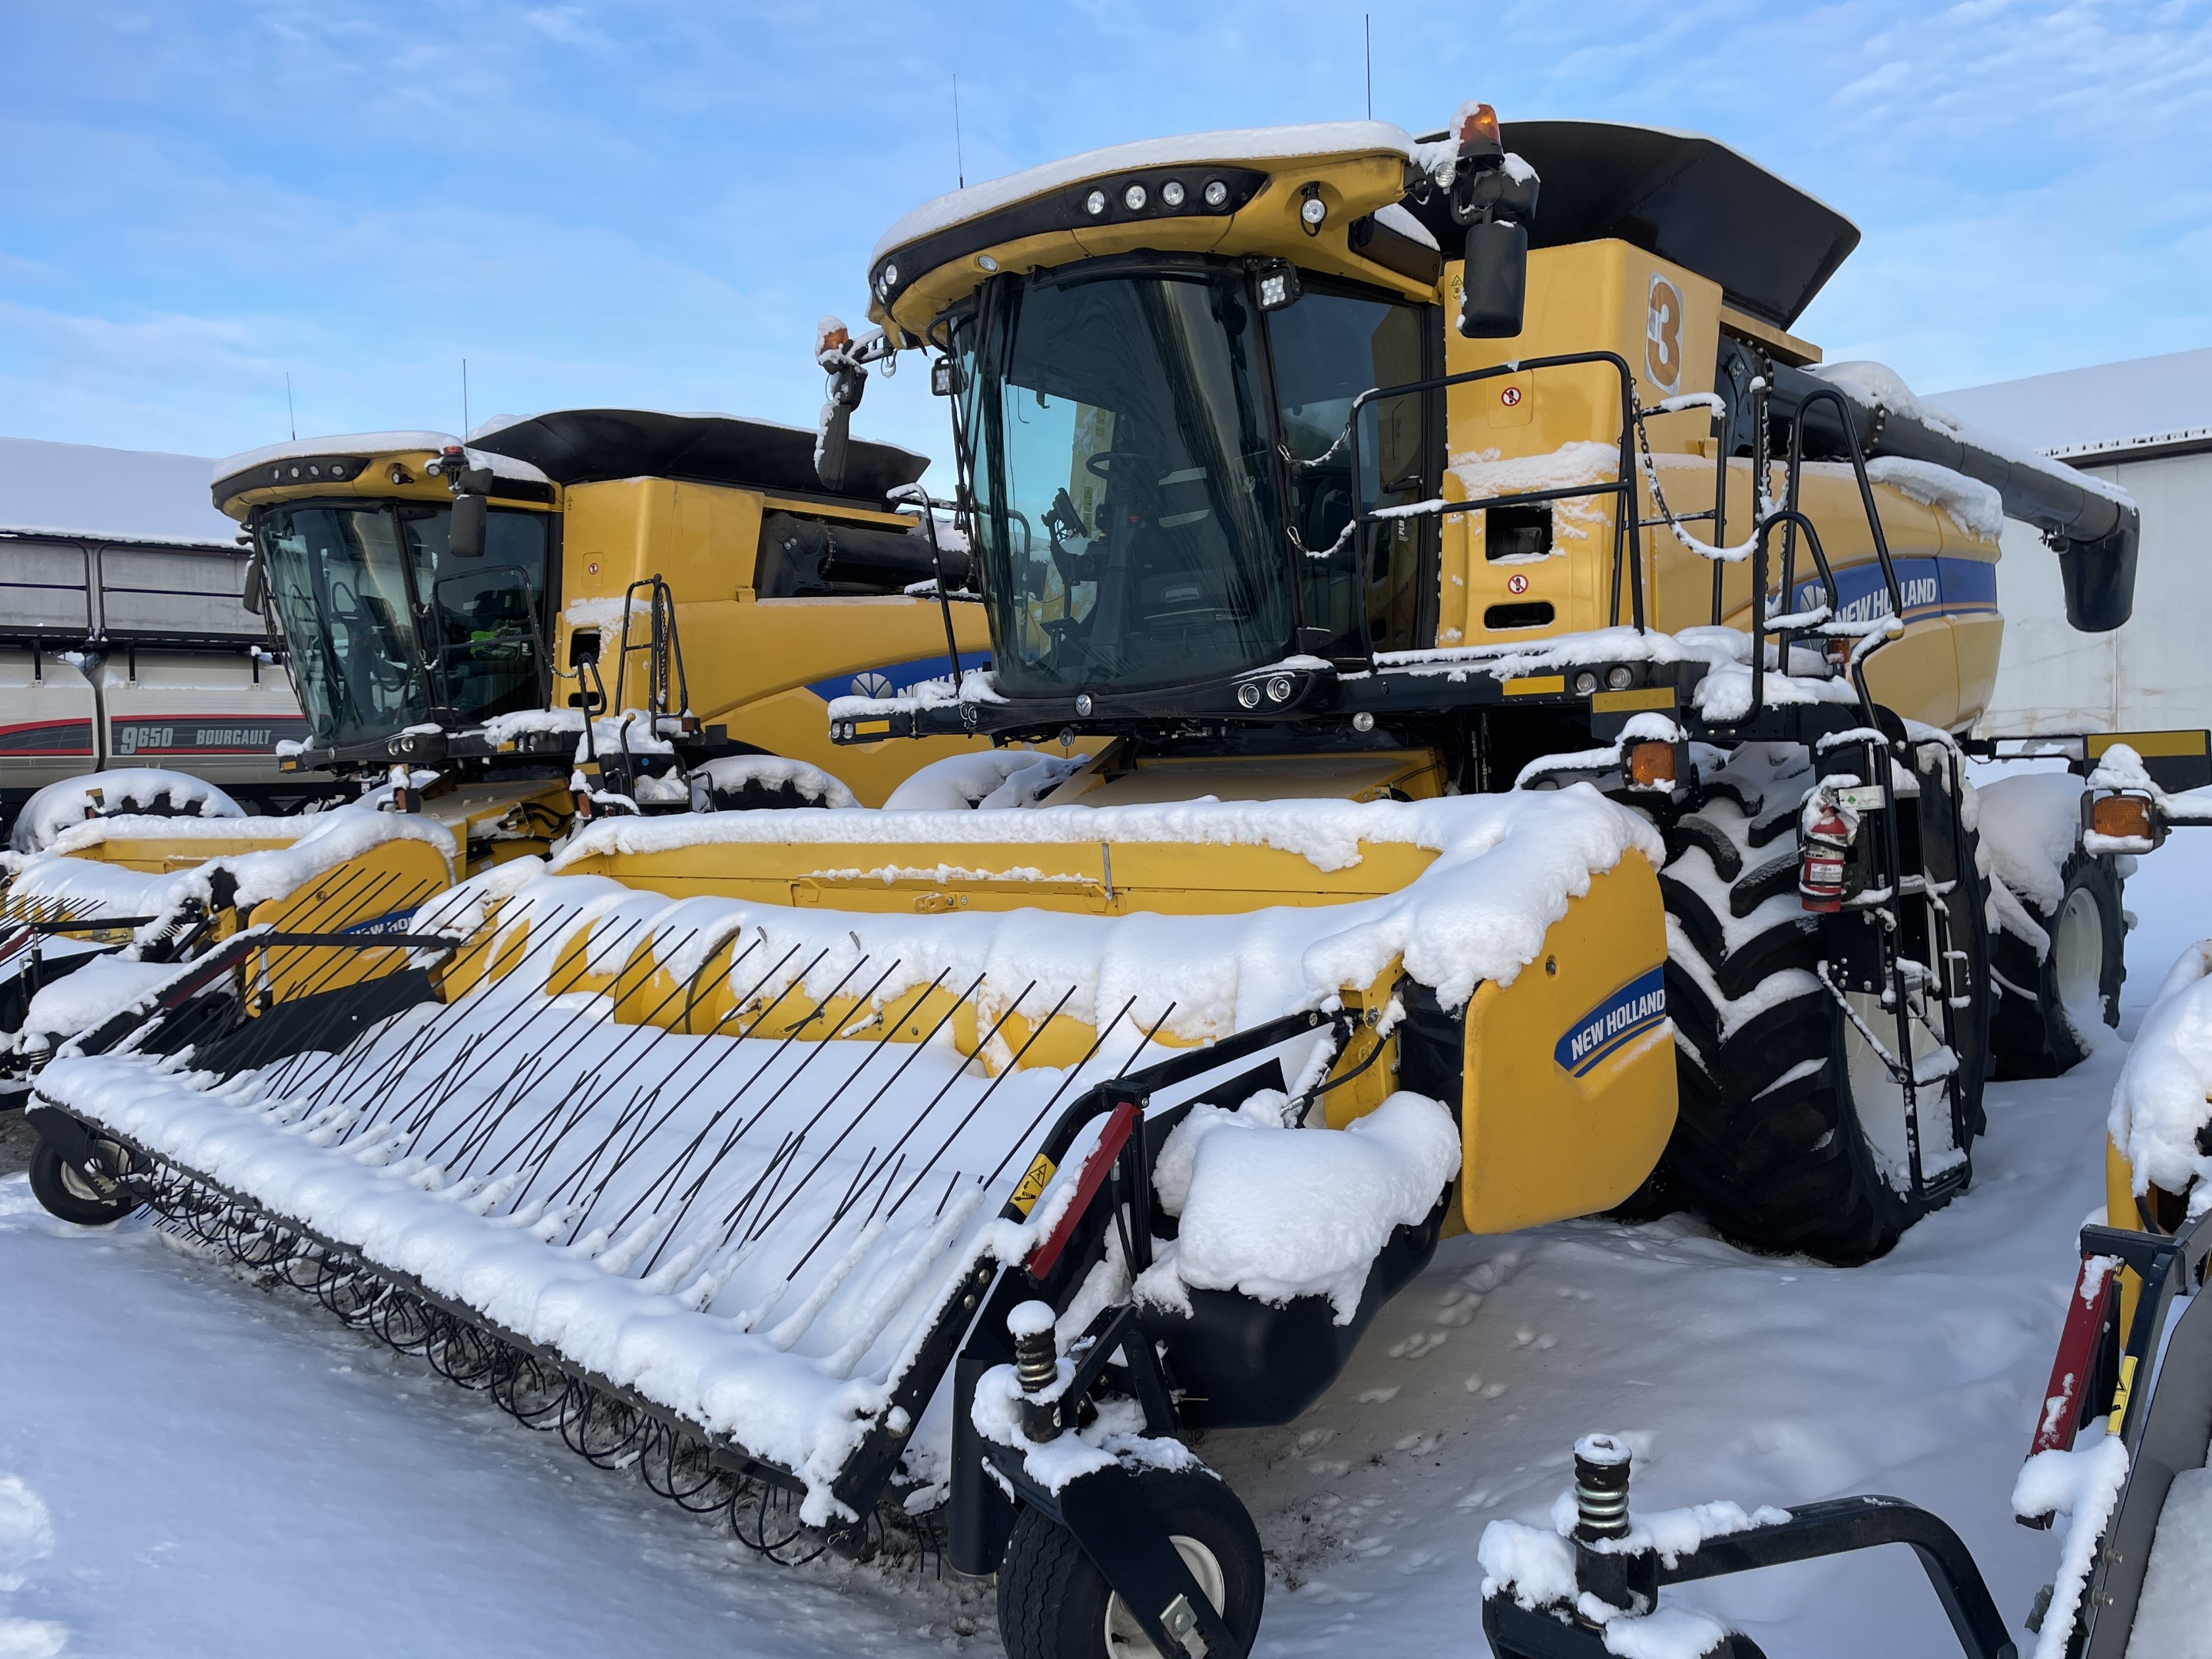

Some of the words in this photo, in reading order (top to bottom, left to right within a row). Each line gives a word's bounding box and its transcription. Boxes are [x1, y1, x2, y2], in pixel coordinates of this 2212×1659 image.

[1648, 282, 1680, 386] 3
[1873, 578, 1936, 618] HOLAND
[120, 727, 174, 754] 9650
[195, 729, 272, 745] BOURGAULT
[1571, 1018, 1604, 1061] NEW
[1606, 988, 1665, 1036] HOLLAND
